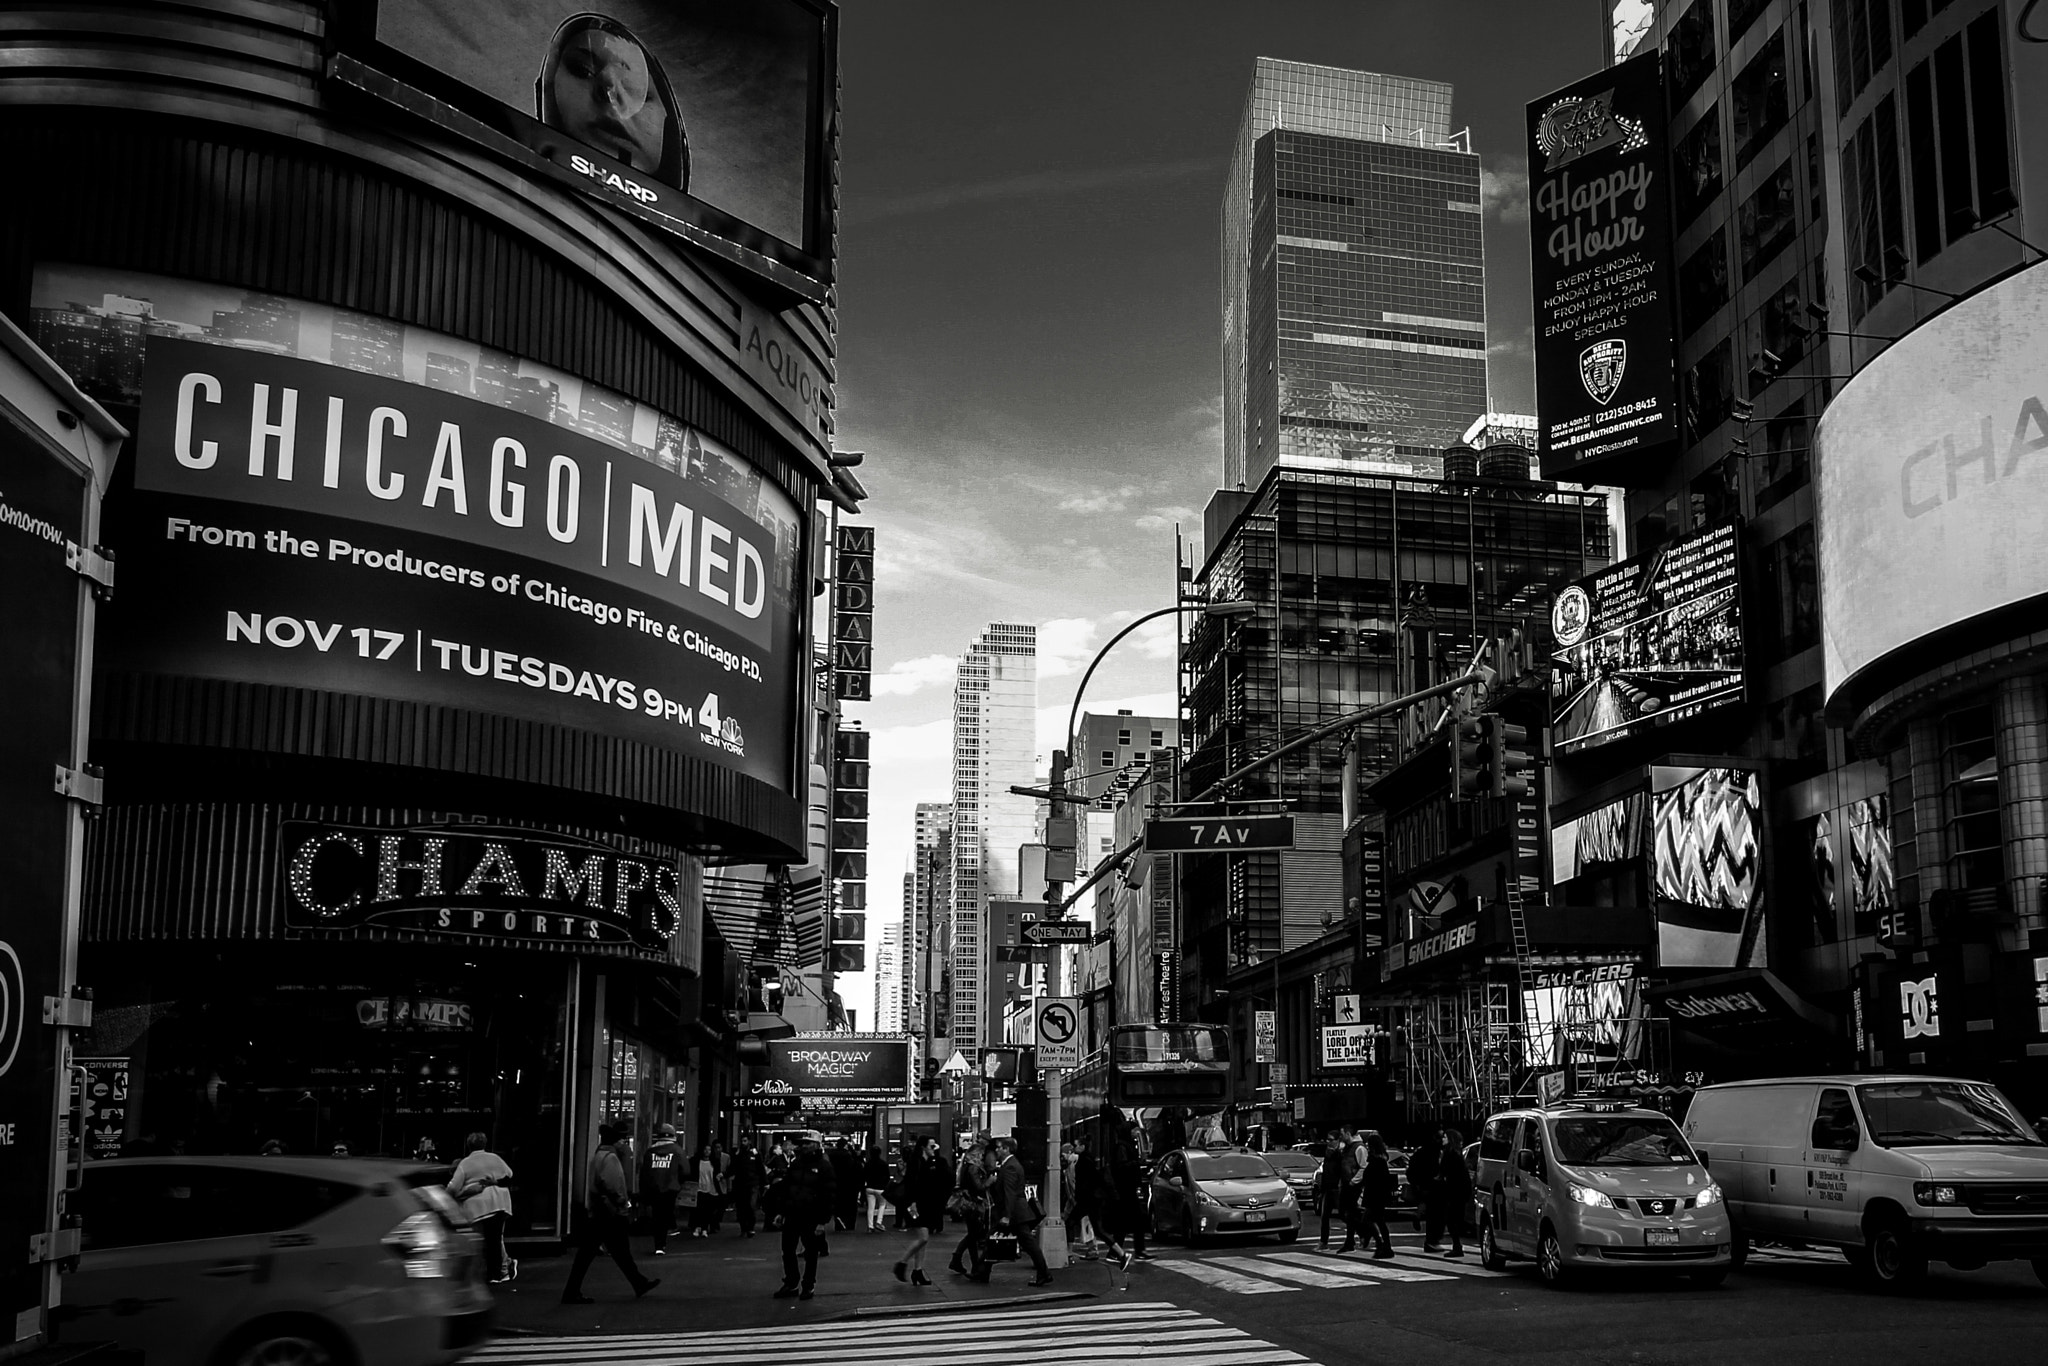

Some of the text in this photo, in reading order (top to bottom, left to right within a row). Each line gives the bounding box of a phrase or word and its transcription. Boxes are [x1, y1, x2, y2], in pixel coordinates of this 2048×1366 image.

[1563, 99, 1604, 130] Late
[570, 154, 658, 204] SHARP
[1536, 162, 1653, 227] Happy
[1548, 216, 1645, 267] Hour
[1543, 260, 1656, 310] MONDAY & TUESDAY
[1556, 269, 1592, 291] EVERY
[1545, 290, 1657, 337] ENJOY HAPPY HOUR
[1553, 279, 1647, 320] FROM 11PM 2AM
[1574, 315, 1628, 341] SPECIALS
[1583, 348, 1623, 367] AUTHORITY
[1592, 342, 1612, 354] BEER
[746, 326, 819, 419] AQUOS
[1487, 413, 1538, 430] CARTE
[175, 372, 765, 619] CHICAGO MED
[0, 491, 64, 546] omorrow.
[167, 517, 763, 682] From the Producers of Chicago Fire & Chicago P.D.
[839, 528, 872, 698] MADAME
[226, 610, 693, 727] NOV 17 TUESDAYS 9PM
[698, 692, 722, 737] 4
[700, 732, 745, 757] NEW YORK
[1189, 826, 1205, 845] 7
[289, 831, 682, 940] CHAMPS
[1364, 837, 1382, 921] VICTORY
[1031, 928, 1082, 937] ONE WAY
[1880, 912, 1907, 940] SE
[1005, 948, 1015, 961] 7
[1408, 920, 1477, 966] SKECHERS
[1326, 1029, 1346, 1037] FLATLEY
[1326, 1037, 1347, 1047] LORD
[1040, 1046, 1076, 1054] 7AM-7PM
[1326, 1048, 1342, 1058] THE
[751, 1079, 793, 1094] Aladdin
[733, 1098, 786, 1107] SEPHORA
[1595, 1104, 1614, 1112] 8P71
